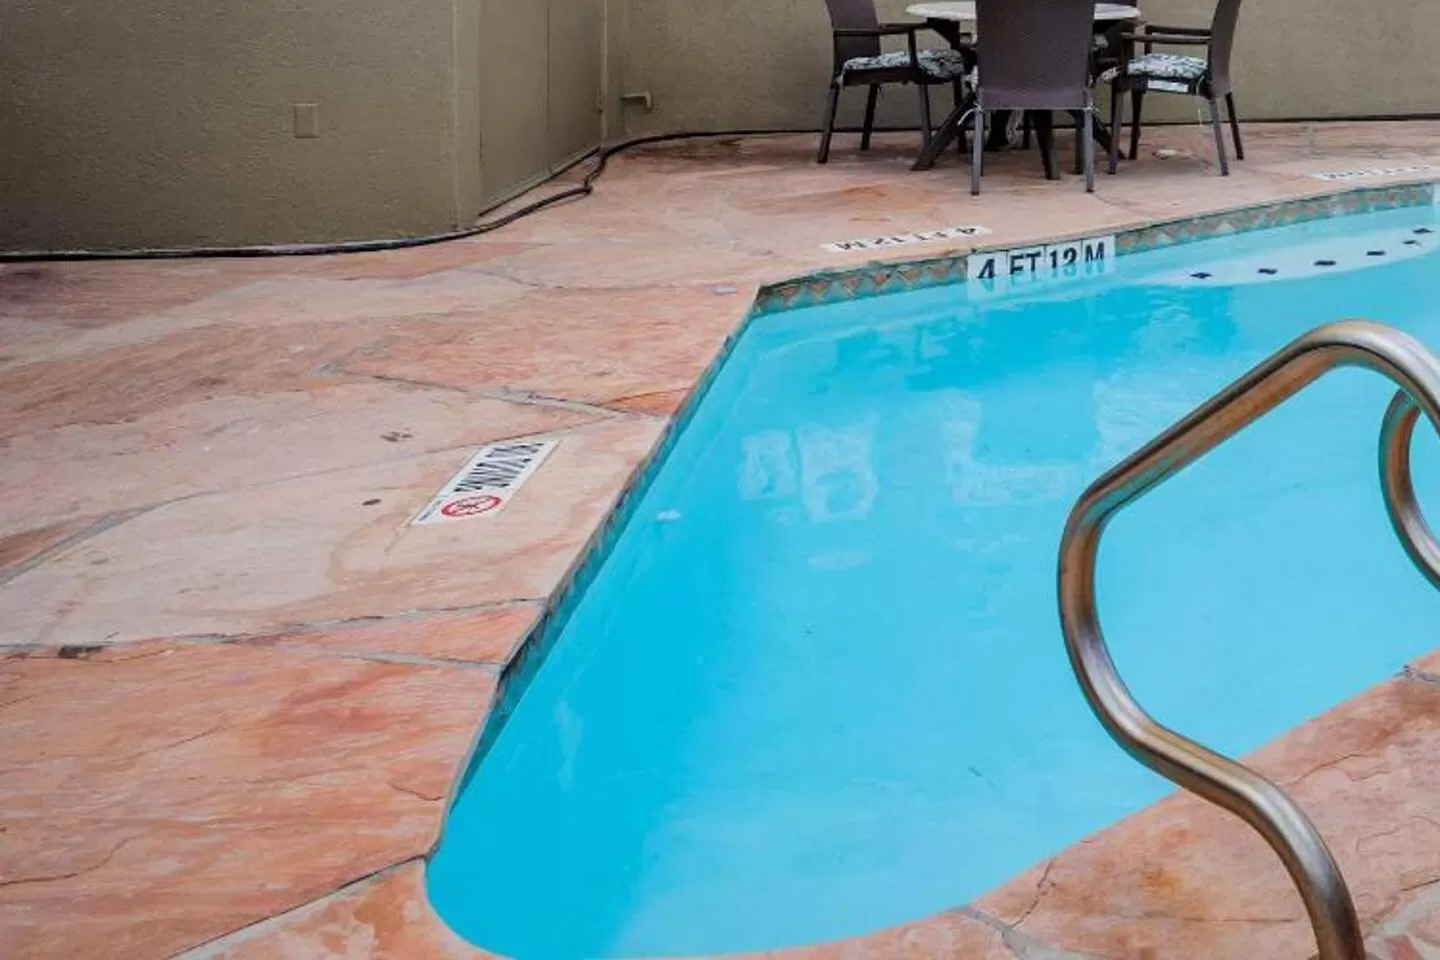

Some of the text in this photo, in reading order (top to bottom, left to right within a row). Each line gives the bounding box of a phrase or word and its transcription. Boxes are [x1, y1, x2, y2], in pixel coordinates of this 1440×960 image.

[977, 258, 996, 279] 4
[1009, 251, 1041, 276] FT
[1085, 242, 1105, 262] M
